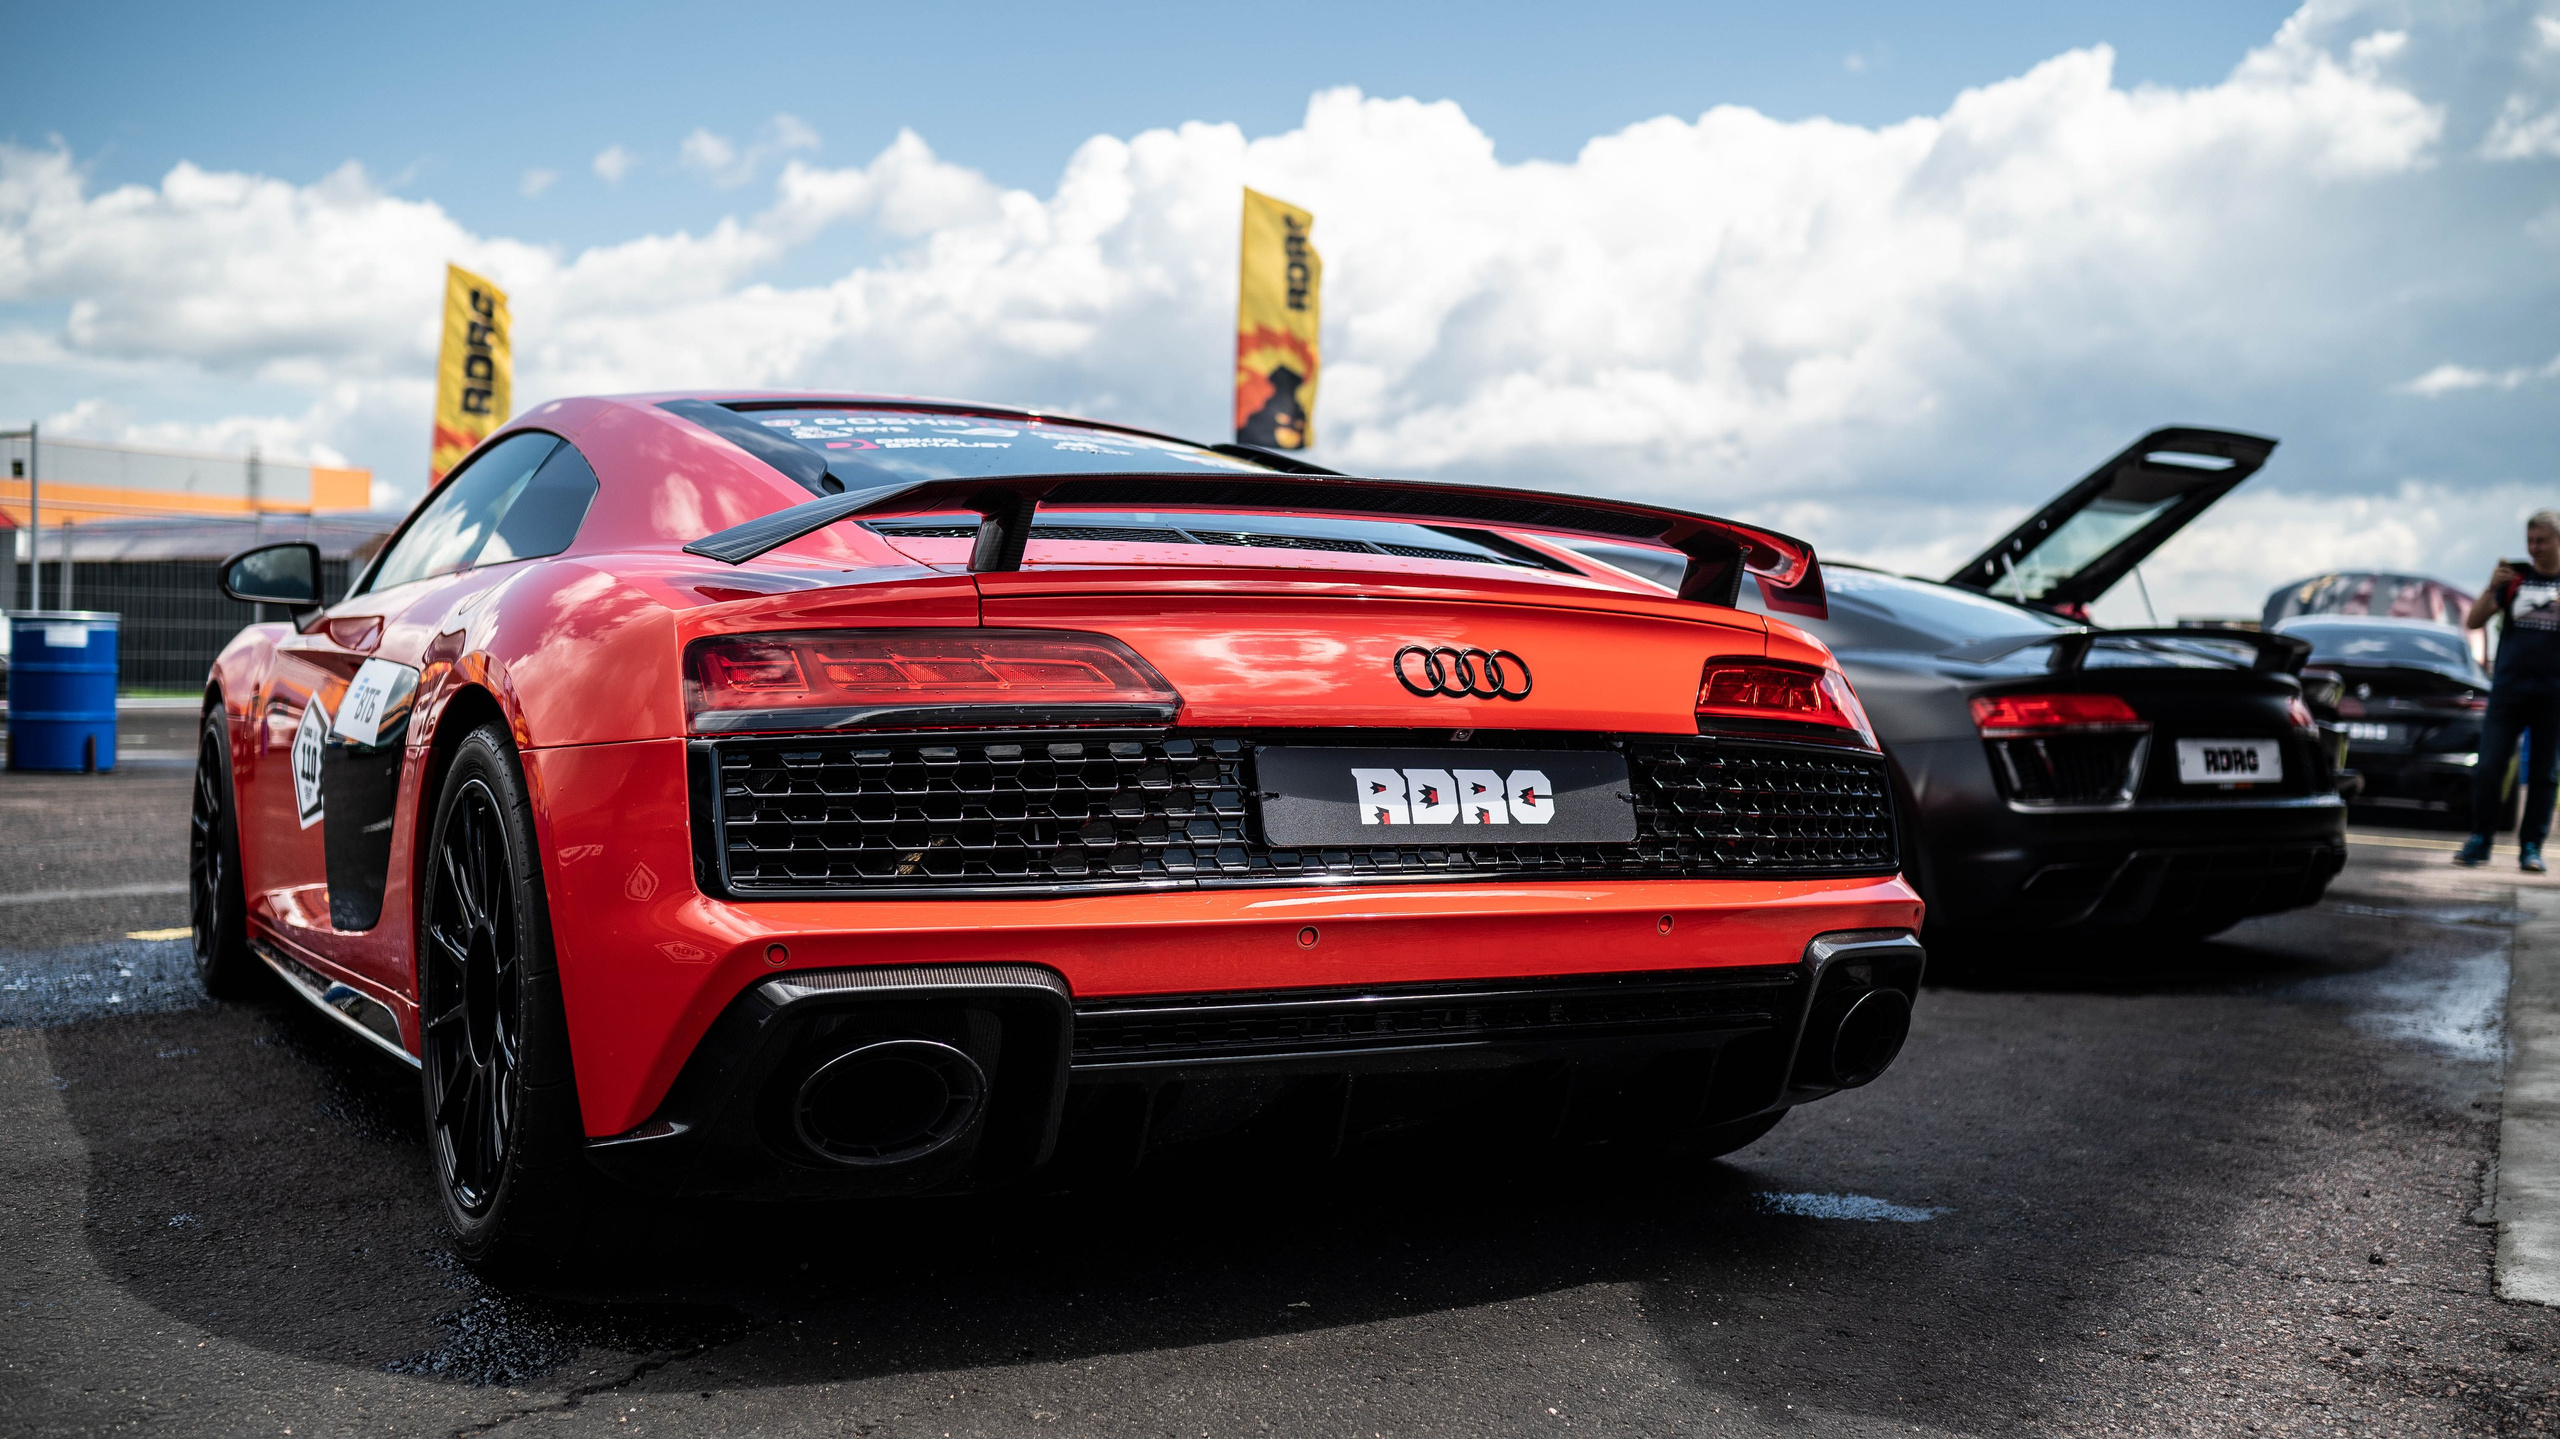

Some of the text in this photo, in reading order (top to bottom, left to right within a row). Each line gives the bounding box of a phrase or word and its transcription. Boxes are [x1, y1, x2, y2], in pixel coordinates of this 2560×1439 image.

[301, 743, 317, 784] 110
[2205, 747, 2260, 774] RDRC
[1351, 768, 1555, 825] RDRC
